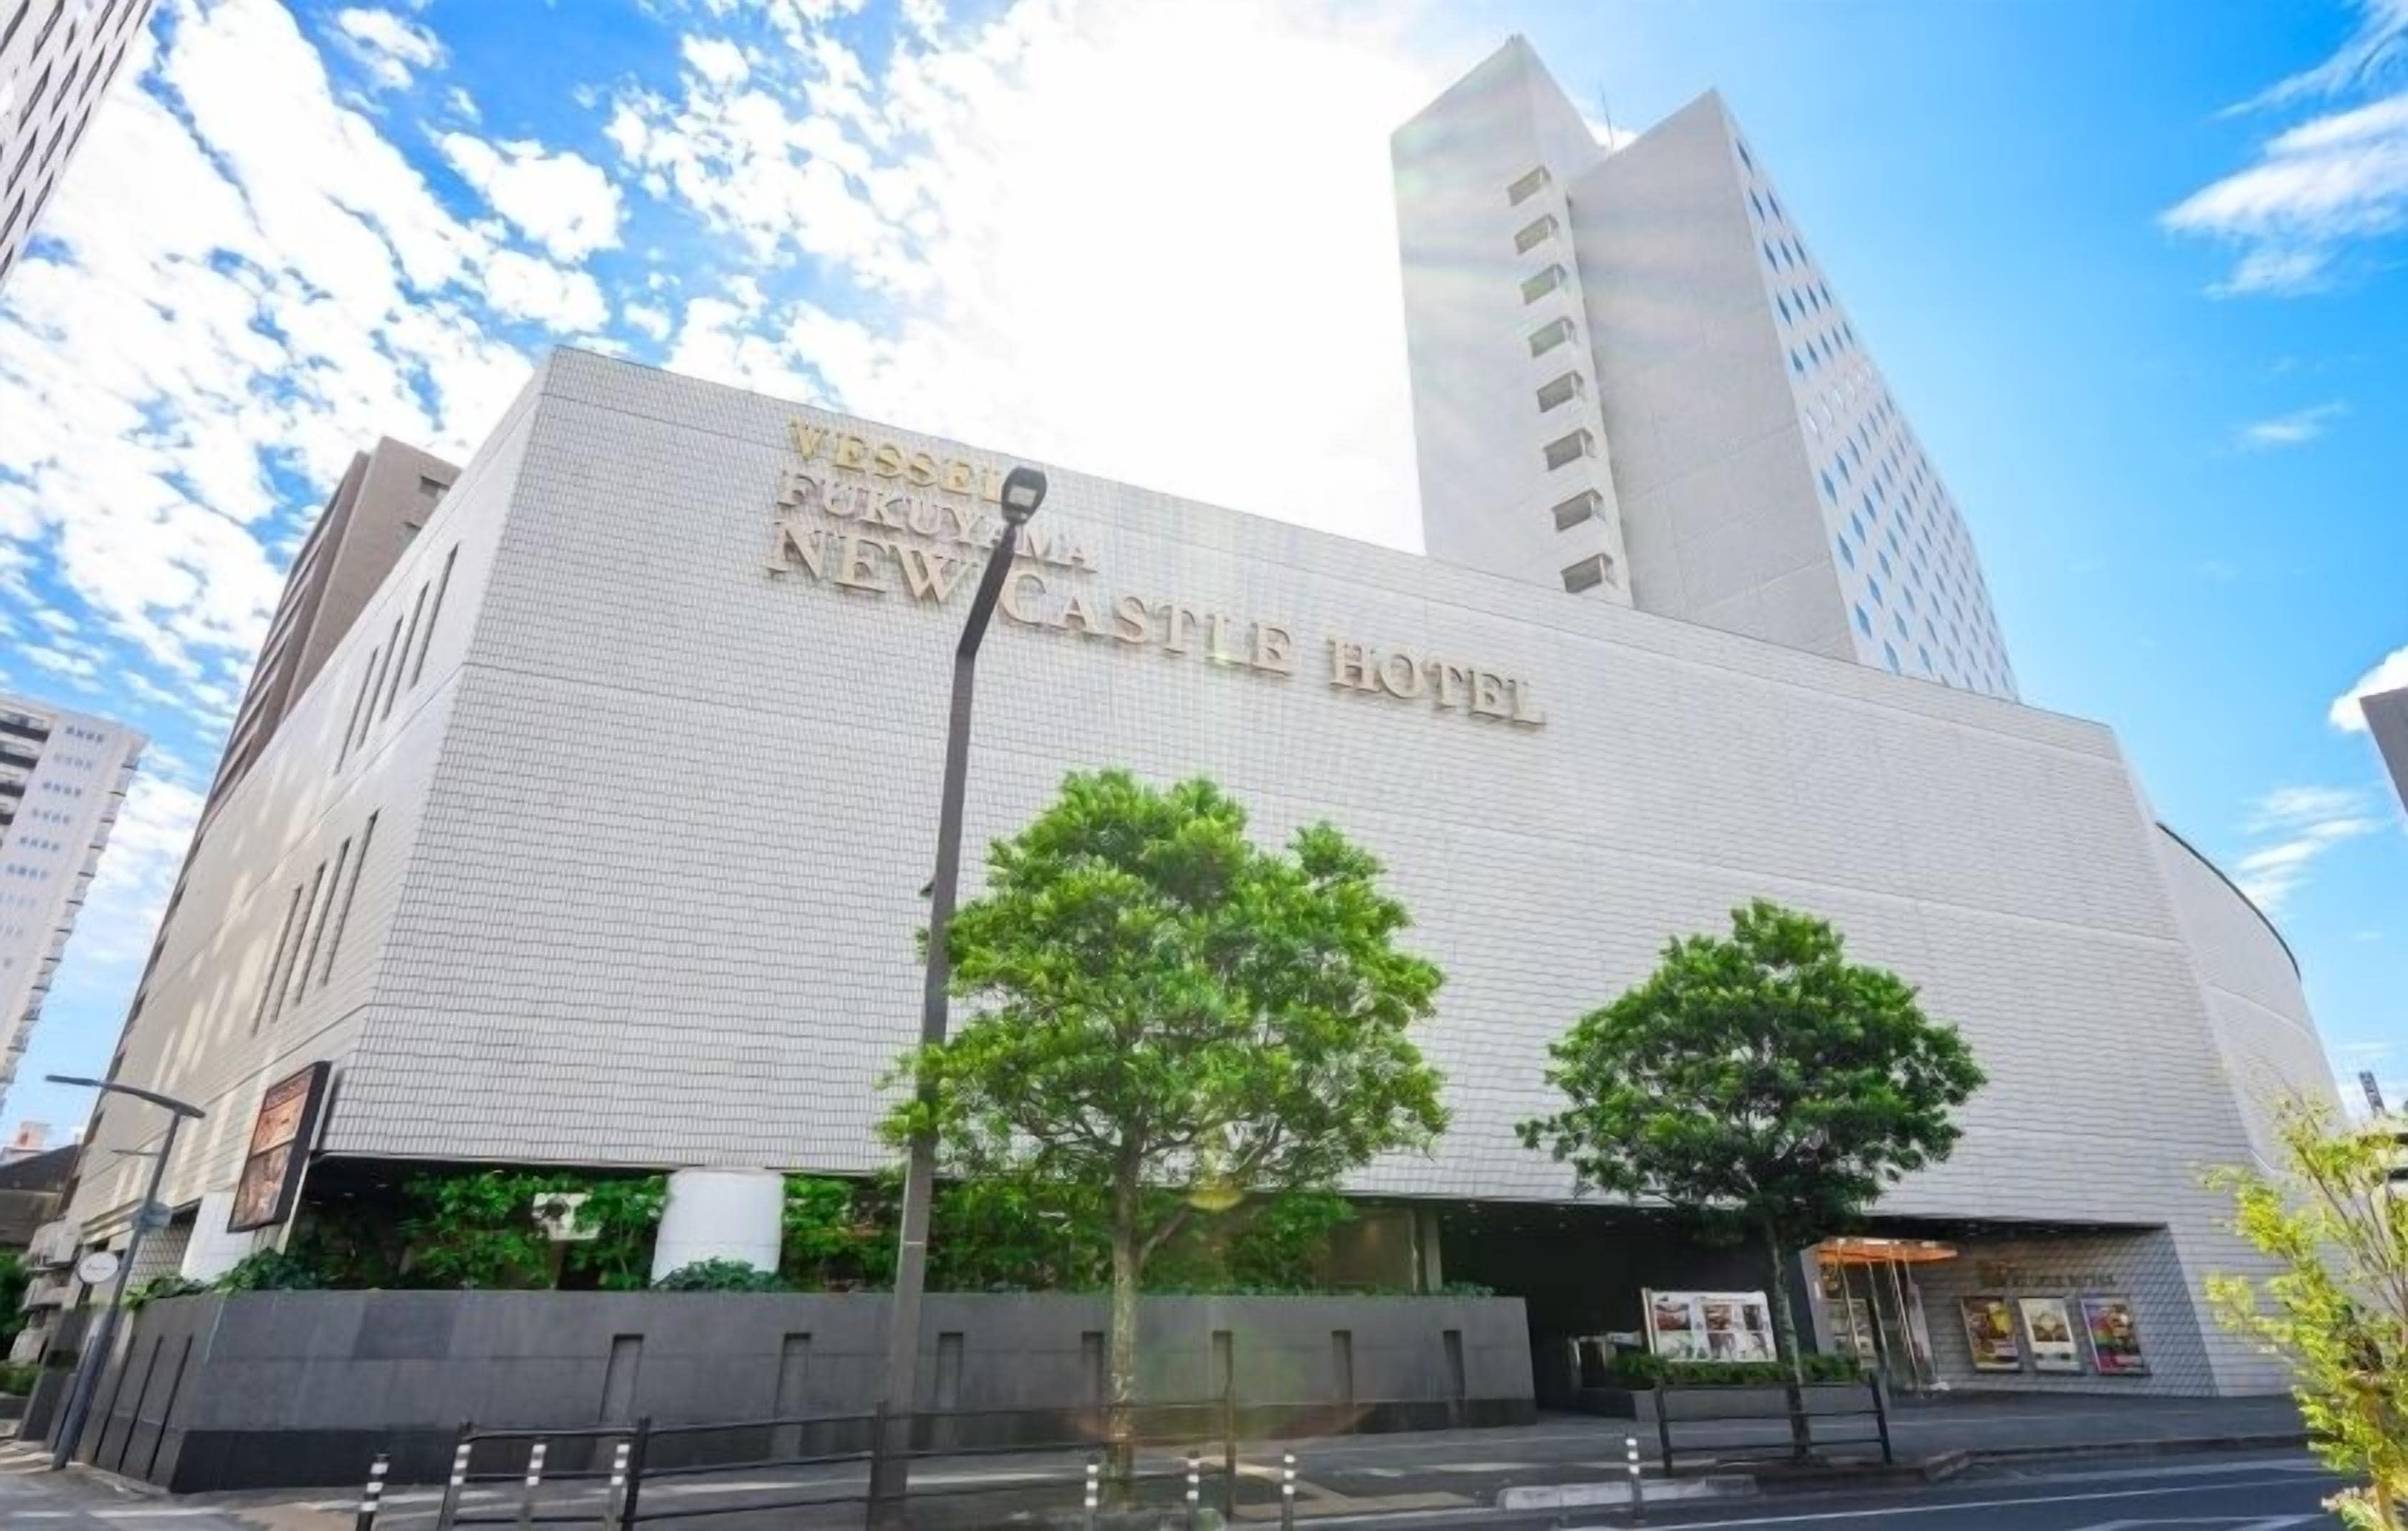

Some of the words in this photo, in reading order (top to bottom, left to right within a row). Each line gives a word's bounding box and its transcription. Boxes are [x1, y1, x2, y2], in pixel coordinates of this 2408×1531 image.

[767, 519, 982, 605] NEW
[1000, 571, 1292, 676] CASTLE
[1328, 636, 1546, 725] HOTEL
